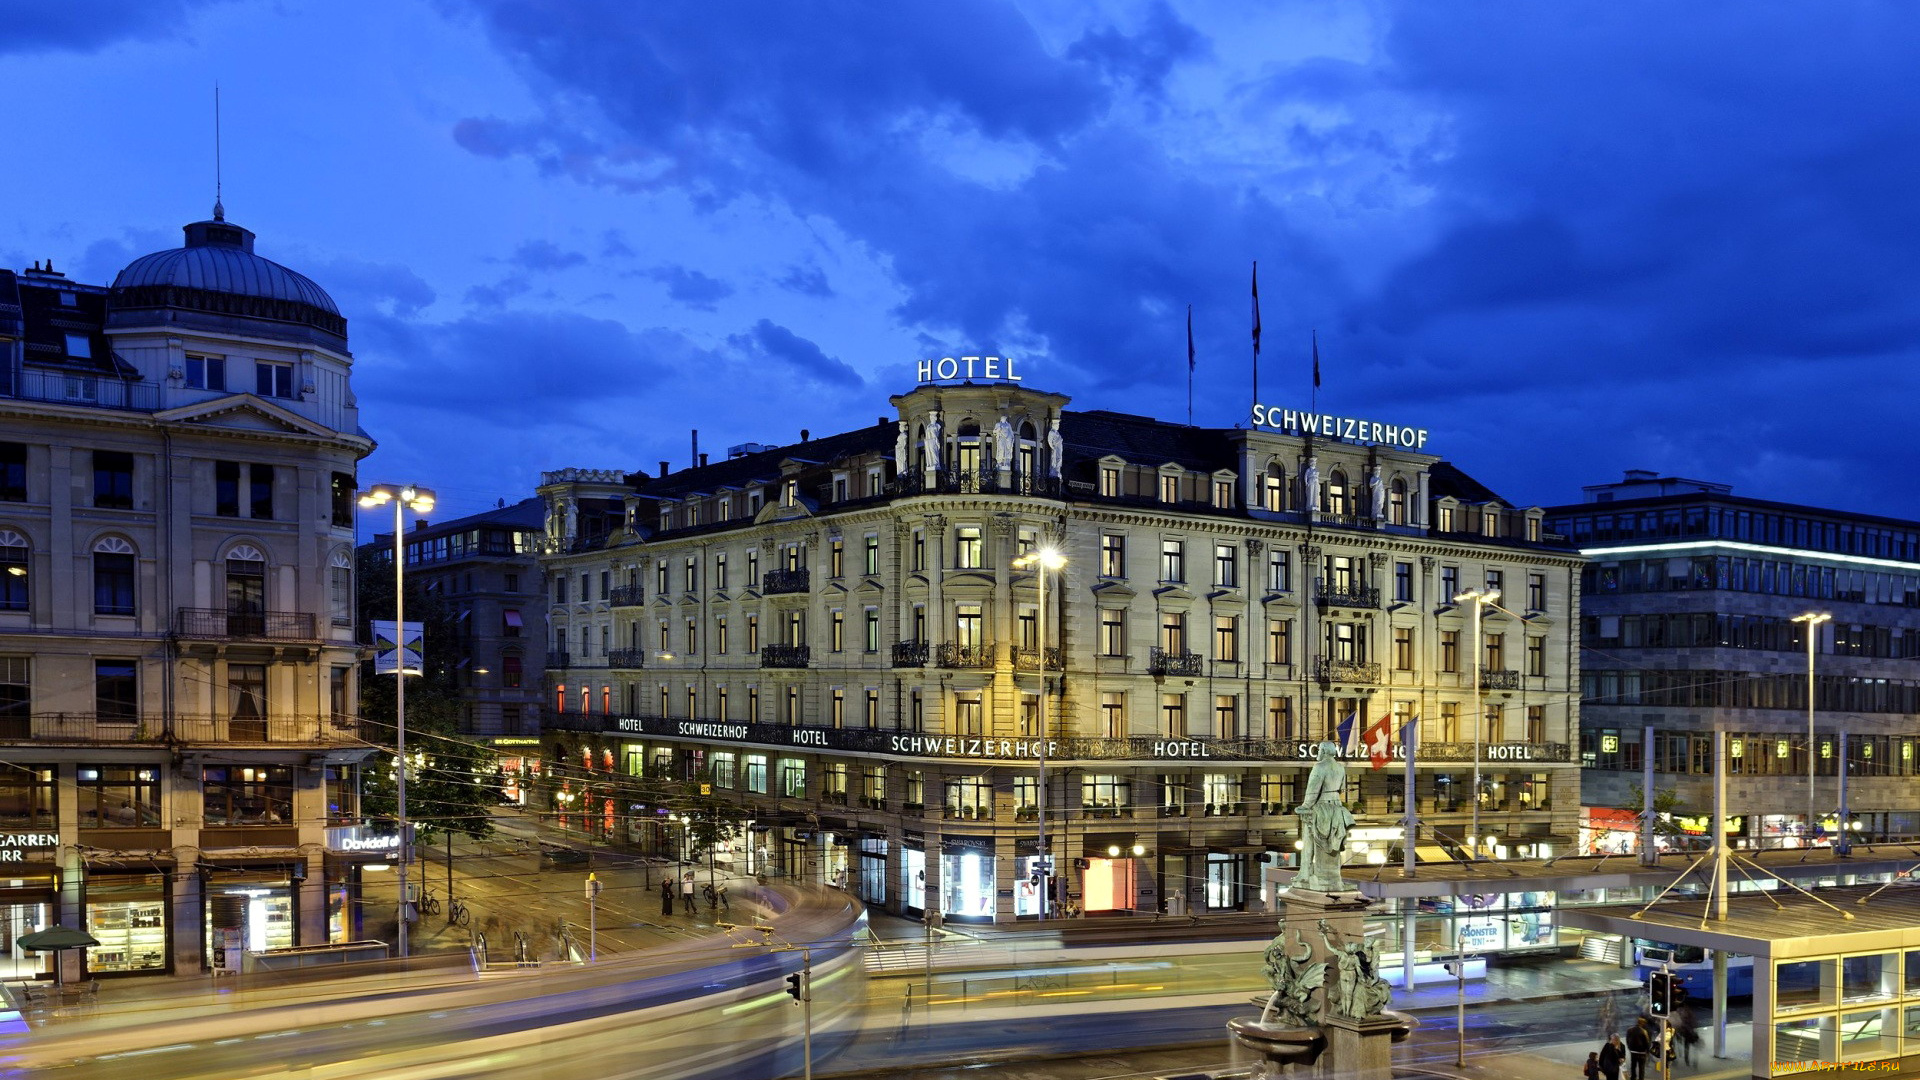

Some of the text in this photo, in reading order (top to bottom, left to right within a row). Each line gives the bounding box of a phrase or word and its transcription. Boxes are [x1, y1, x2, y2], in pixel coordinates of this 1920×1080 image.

[918, 356, 1022, 382] HOTEL
[1252, 404, 1428, 448] SCHWEIZERHOF
[619, 718, 643, 731] HOTEL
[679, 721, 748, 739] SCHWEIZERHOF
[793, 729, 828, 745] HOTEL
[892, 735, 1057, 757] SCHWEIZERHOF
[1154, 742, 1210, 757] HOTEL
[1488, 746, 1532, 760] HOTEL
[951, 839, 987, 847] SWAROVSKI
[0, 850, 23, 862] RR
[1460, 923, 1498, 937] MONSTER
